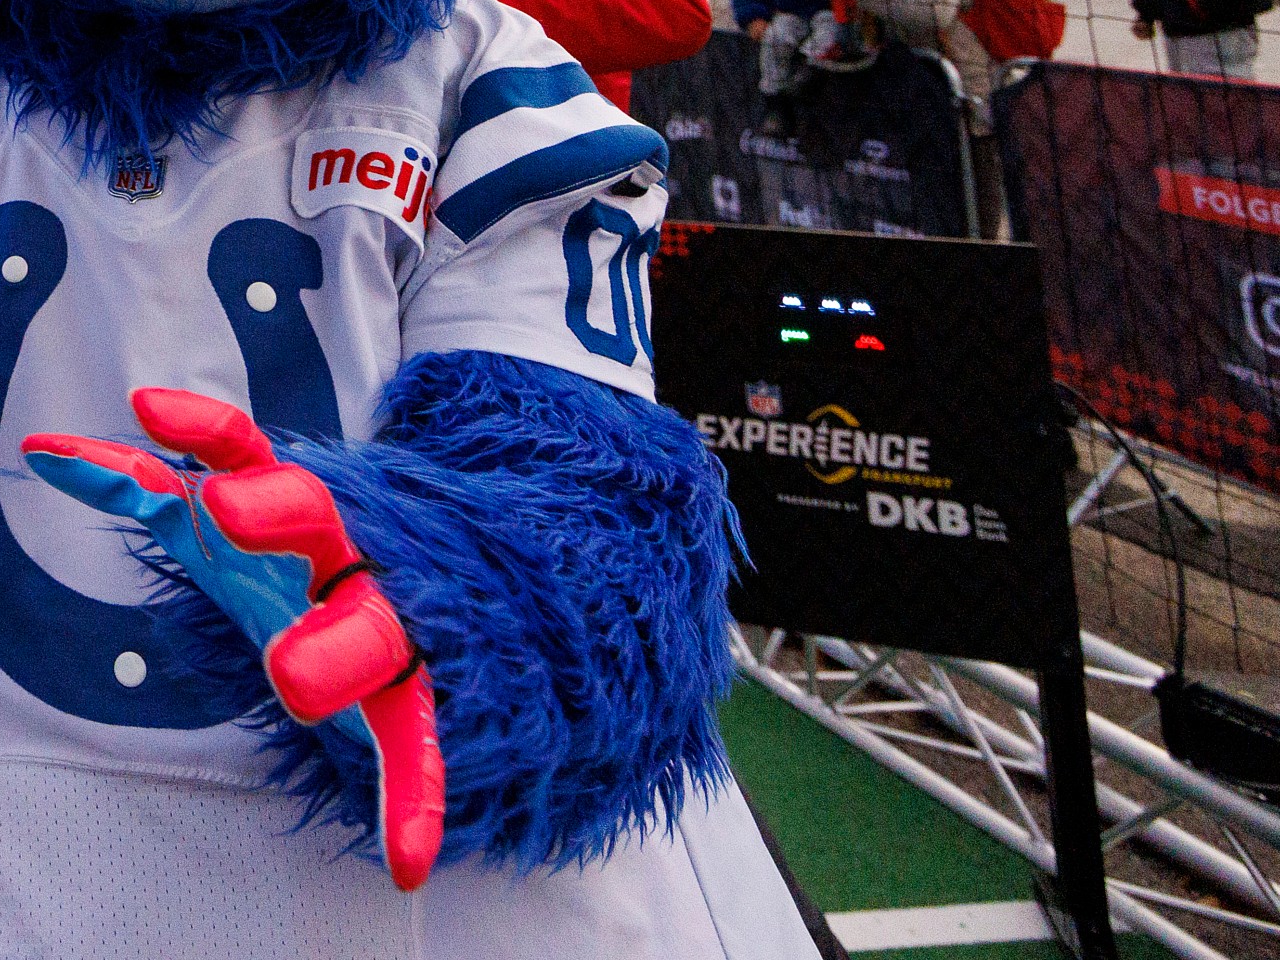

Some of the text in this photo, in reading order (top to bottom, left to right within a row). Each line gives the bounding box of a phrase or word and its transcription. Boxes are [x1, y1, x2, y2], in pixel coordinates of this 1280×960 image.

[114, 170, 156, 192] NFL
[697, 413, 931, 472] EXPERIENCE
[866, 490, 970, 537] DKB
